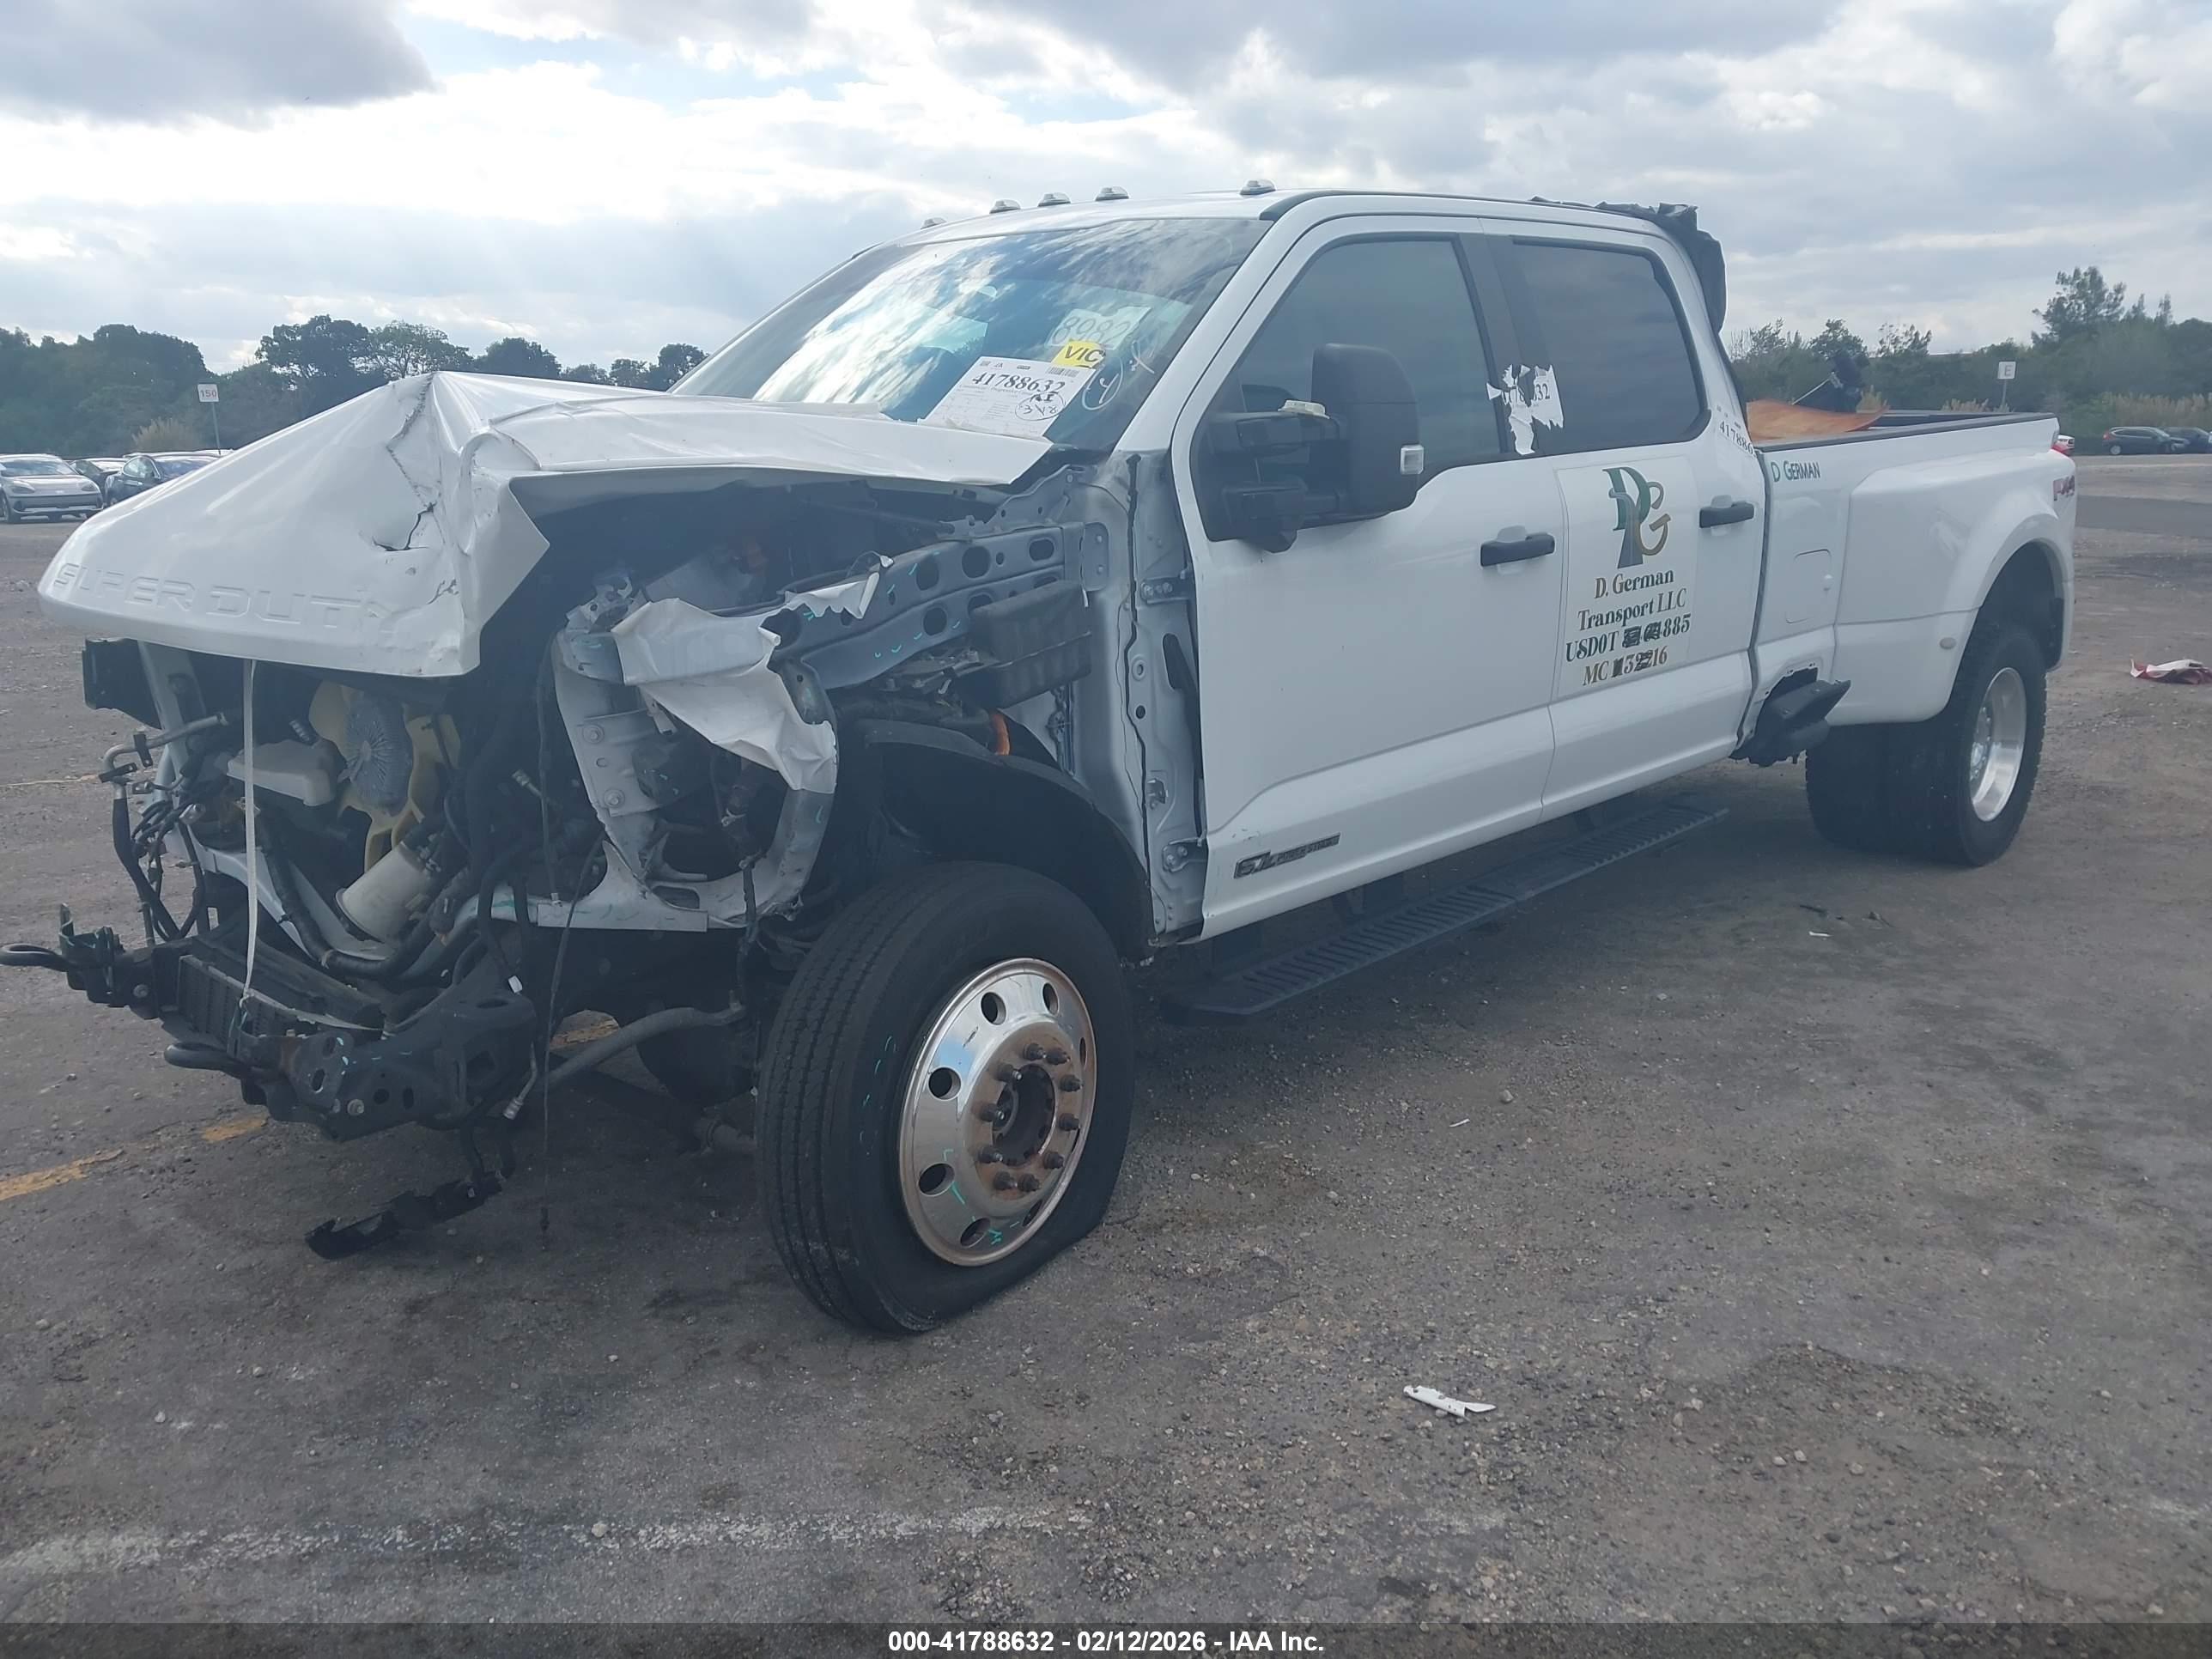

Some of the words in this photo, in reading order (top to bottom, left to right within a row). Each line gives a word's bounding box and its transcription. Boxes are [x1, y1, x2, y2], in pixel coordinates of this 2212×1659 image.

[972, 371, 1066, 395] 41788632
[1771, 461, 1781, 483] D
[1783, 460, 1821, 481] GERMAN
[53, 562, 198, 612] SUPER
[1595, 576, 1609, 599] D.
[1612, 570, 1674, 595] German
[1577, 599, 1655, 631] Transport
[1657, 587, 1687, 613] LLC
[1566, 630, 1620, 662] USDOT
[1583, 660, 1609, 686] MC
